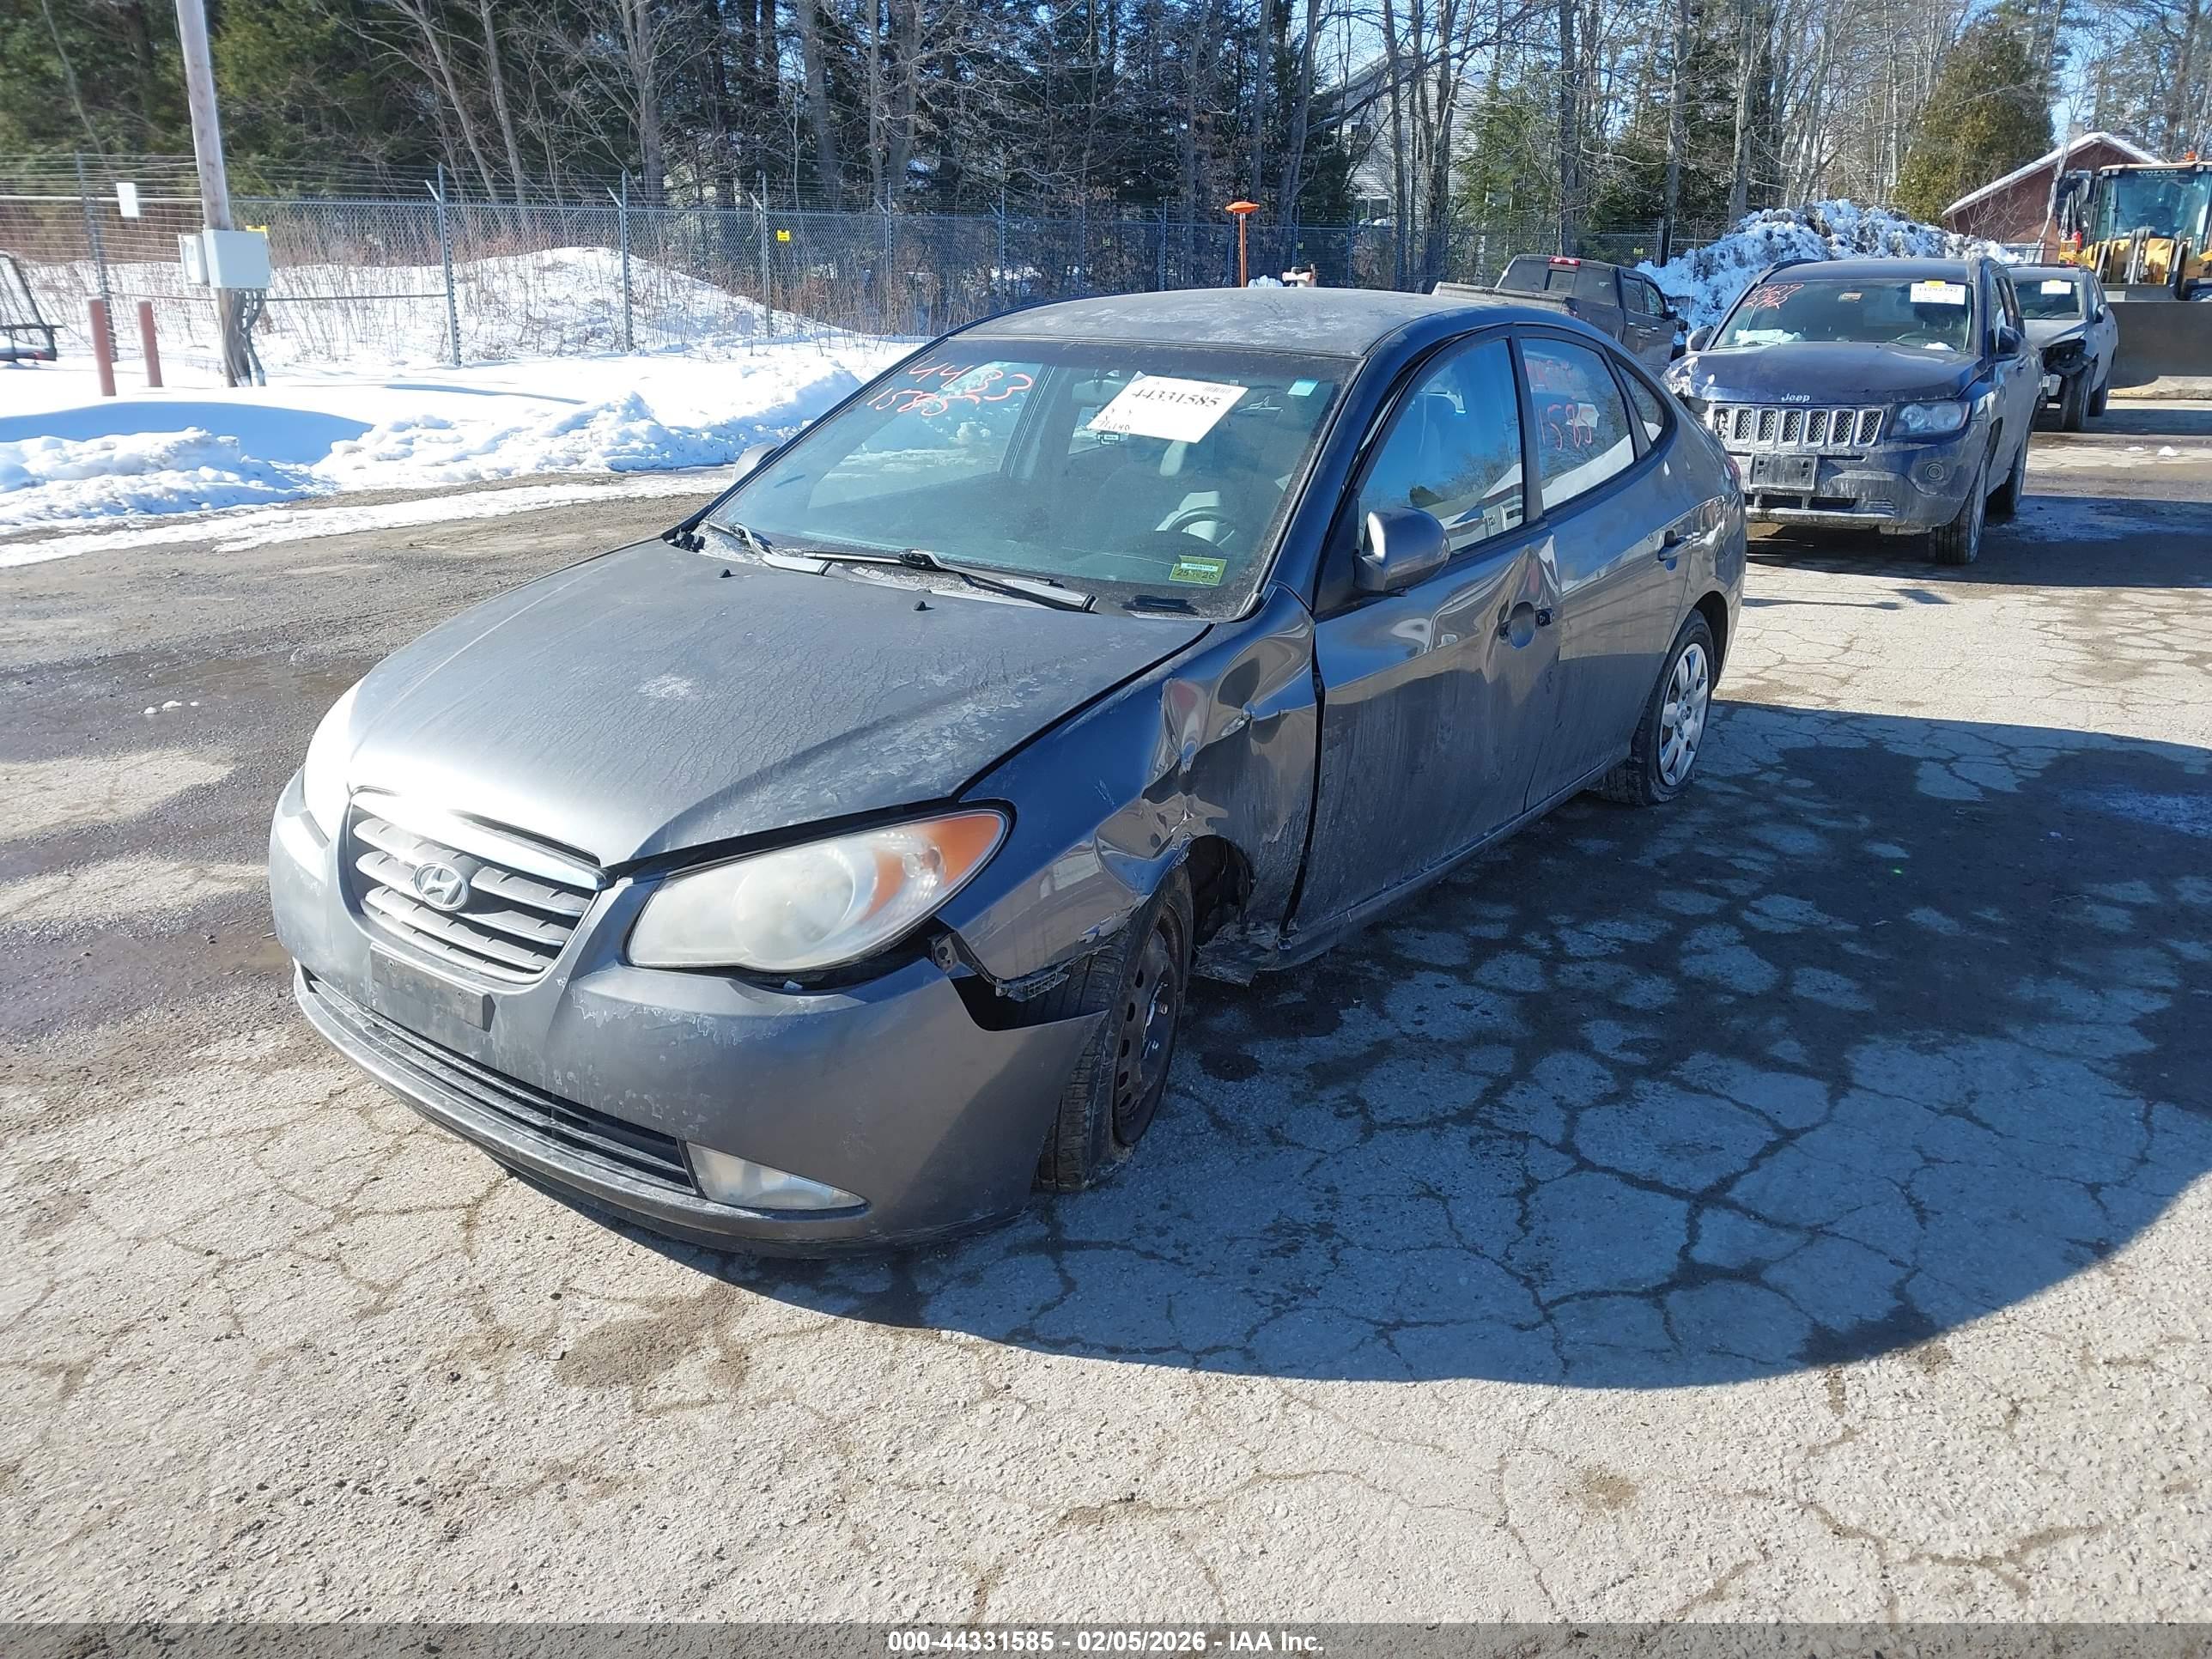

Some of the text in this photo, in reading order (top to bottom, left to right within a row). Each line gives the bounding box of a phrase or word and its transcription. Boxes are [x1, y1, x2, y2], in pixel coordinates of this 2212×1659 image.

[908, 356, 1034, 401] 4433
[1131, 388, 1223, 408] 44331585
[1781, 392, 1812, 403] Jeep
